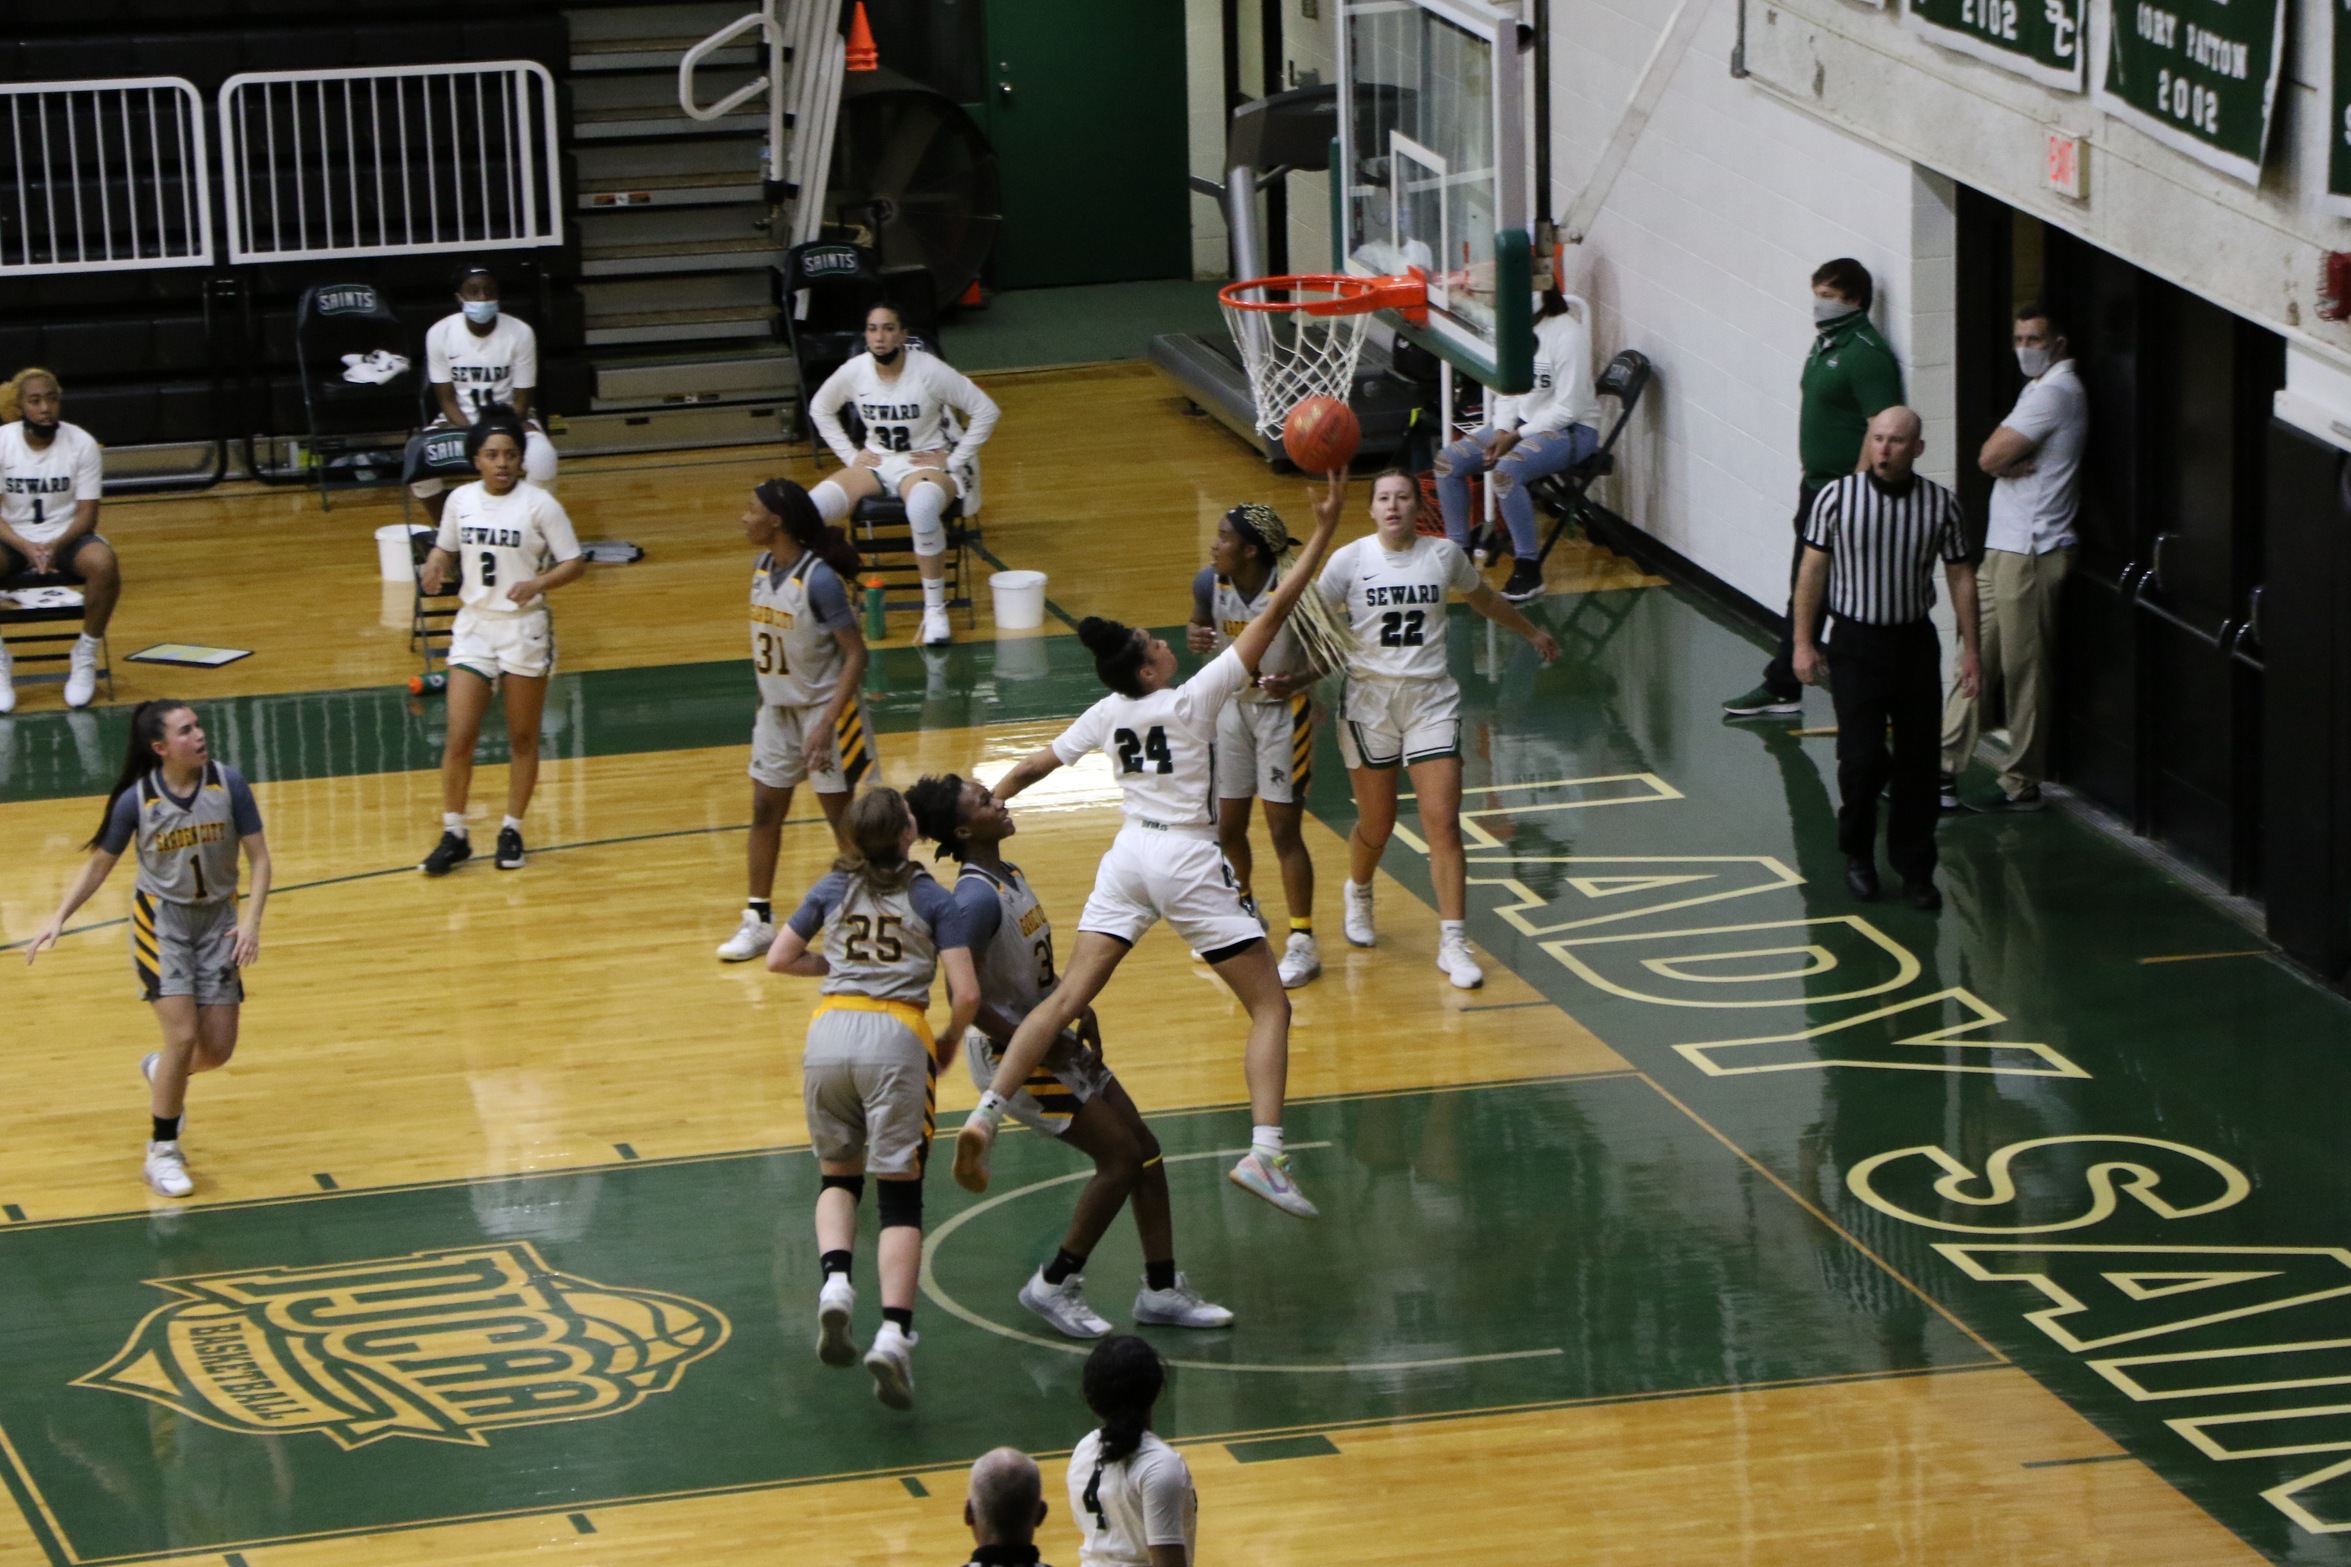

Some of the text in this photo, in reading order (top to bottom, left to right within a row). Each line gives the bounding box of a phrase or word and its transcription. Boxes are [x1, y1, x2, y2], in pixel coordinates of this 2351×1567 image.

[804, 253, 856, 271] SAINTS
[320, 291, 375, 310] SAINTS
[862, 404, 920, 420] SEWARD
[427, 440, 465, 462] SAIN
[874, 426, 911, 453] 32
[5, 477, 70, 493] SEWARD
[32, 499, 44, 524] 1
[460, 527, 521, 547] SEWARD
[480, 552, 496, 587] 2
[1366, 584, 1439, 607] SEWARD
[1381, 610, 1425, 647] 22
[756, 632, 790, 675] 31
[1114, 725, 1173, 775] 24
[201, 822, 225, 843] CITY
[190, 854, 208, 899] 1
[846, 914, 903, 963] 25
[1350, 772, 2092, 1079] LADY
[1035, 931, 1054, 989] 3
[189, 1323, 311, 1421] BASKETBALL
[1082, 1468, 1107, 1530] 4
